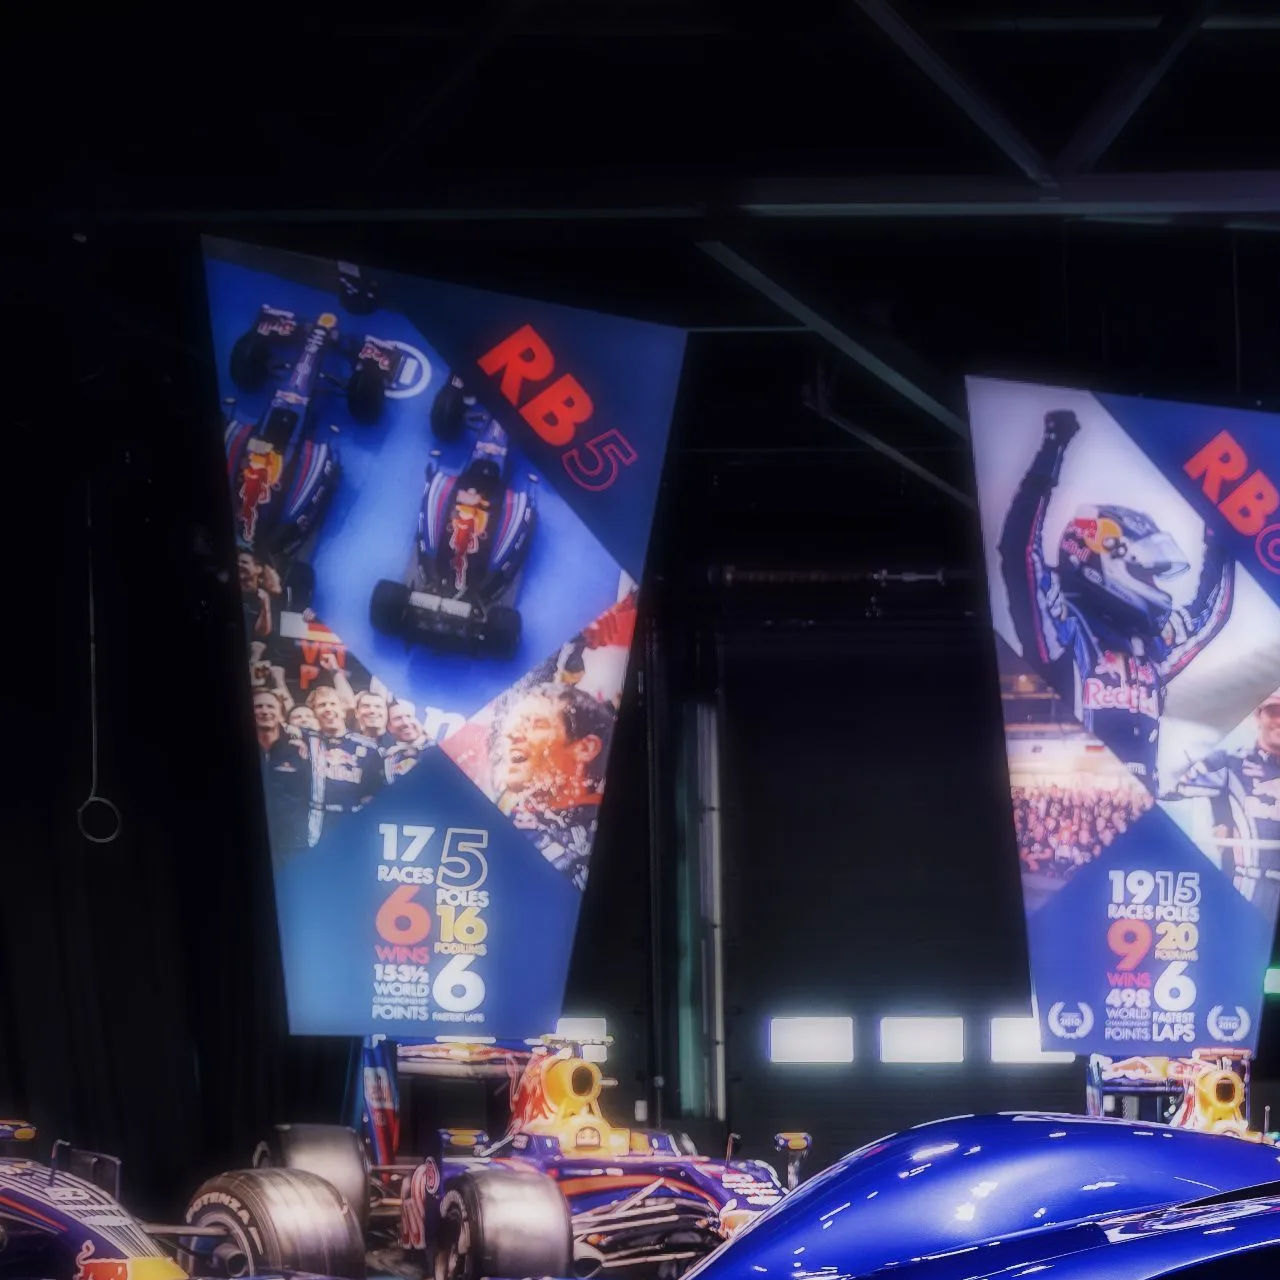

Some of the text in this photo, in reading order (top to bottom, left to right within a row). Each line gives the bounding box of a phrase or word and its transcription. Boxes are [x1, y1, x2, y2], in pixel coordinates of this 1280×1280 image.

[477, 323, 638, 491] RB5
[379, 823, 436, 862] 17
[436, 827, 488, 890] 5
[377, 865, 434, 884] RACES
[1109, 869, 1155, 904] 19
[1155, 871, 1202, 907] 15
[436, 889, 489, 907] POLES
[375, 885, 432, 945] 6
[436, 905, 488, 944] 16
[1107, 918, 1153, 972] 9
[1155, 922, 1199, 951] 20
[375, 945, 430, 965] WINS
[432, 954, 486, 1013] 6
[1106, 971, 1151, 988] WINS
[1153, 961, 1197, 1012] 6
[372, 1004, 430, 1021] POINTS
[1105, 988, 1151, 1008] 498
[1105, 1007, 1151, 1021] WORLD
[1104, 1027, 1151, 1042] POINTS
[1152, 1023, 1196, 1043] LAPS
